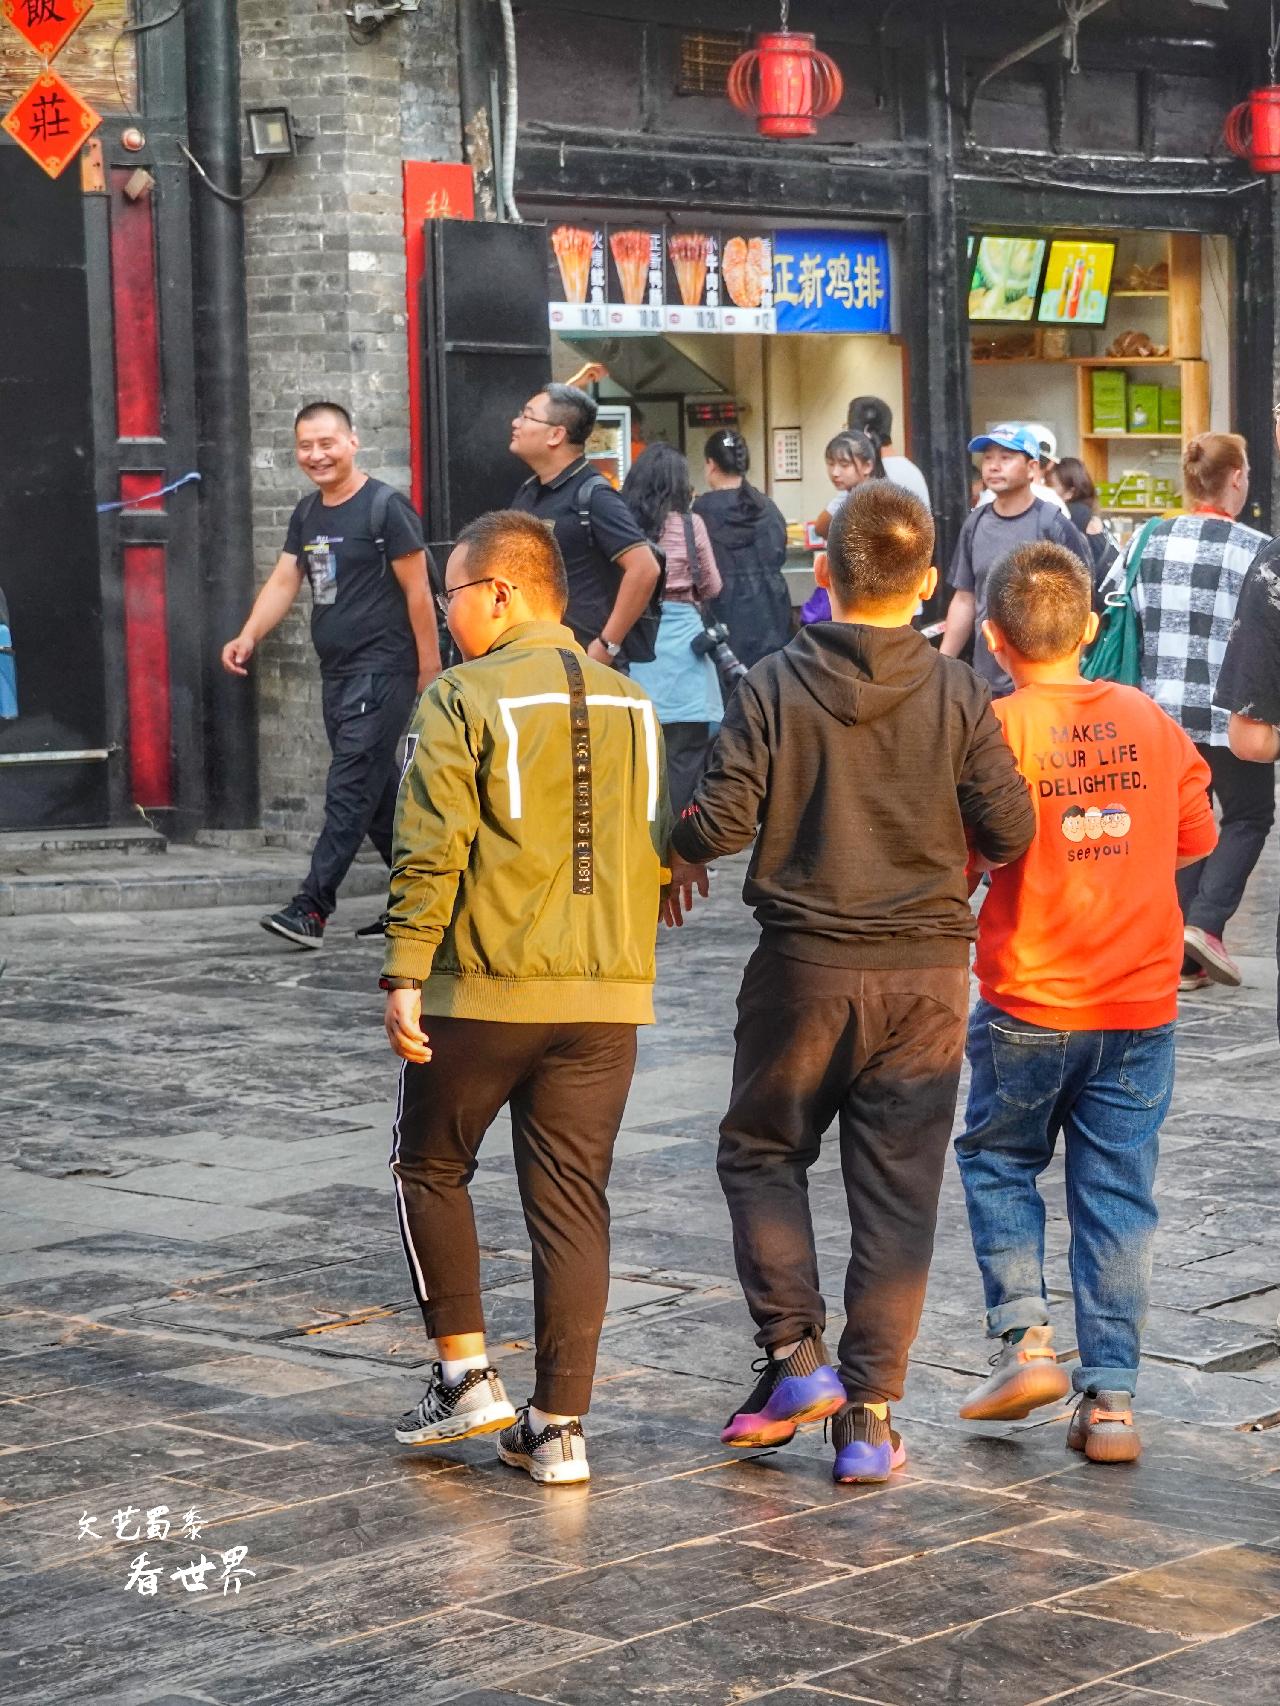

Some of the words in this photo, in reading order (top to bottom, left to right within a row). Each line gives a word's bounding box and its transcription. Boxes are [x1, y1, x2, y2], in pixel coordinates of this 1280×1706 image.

[29, 92, 71, 143] 莊
[773, 252, 884, 309] 正新鸡排
[1050, 721, 1118, 744] MAKES
[1033, 749, 1086, 771] YOUR
[1098, 743, 1138, 766] LIFE
[1039, 771, 1147, 798] DELIGHTED.
